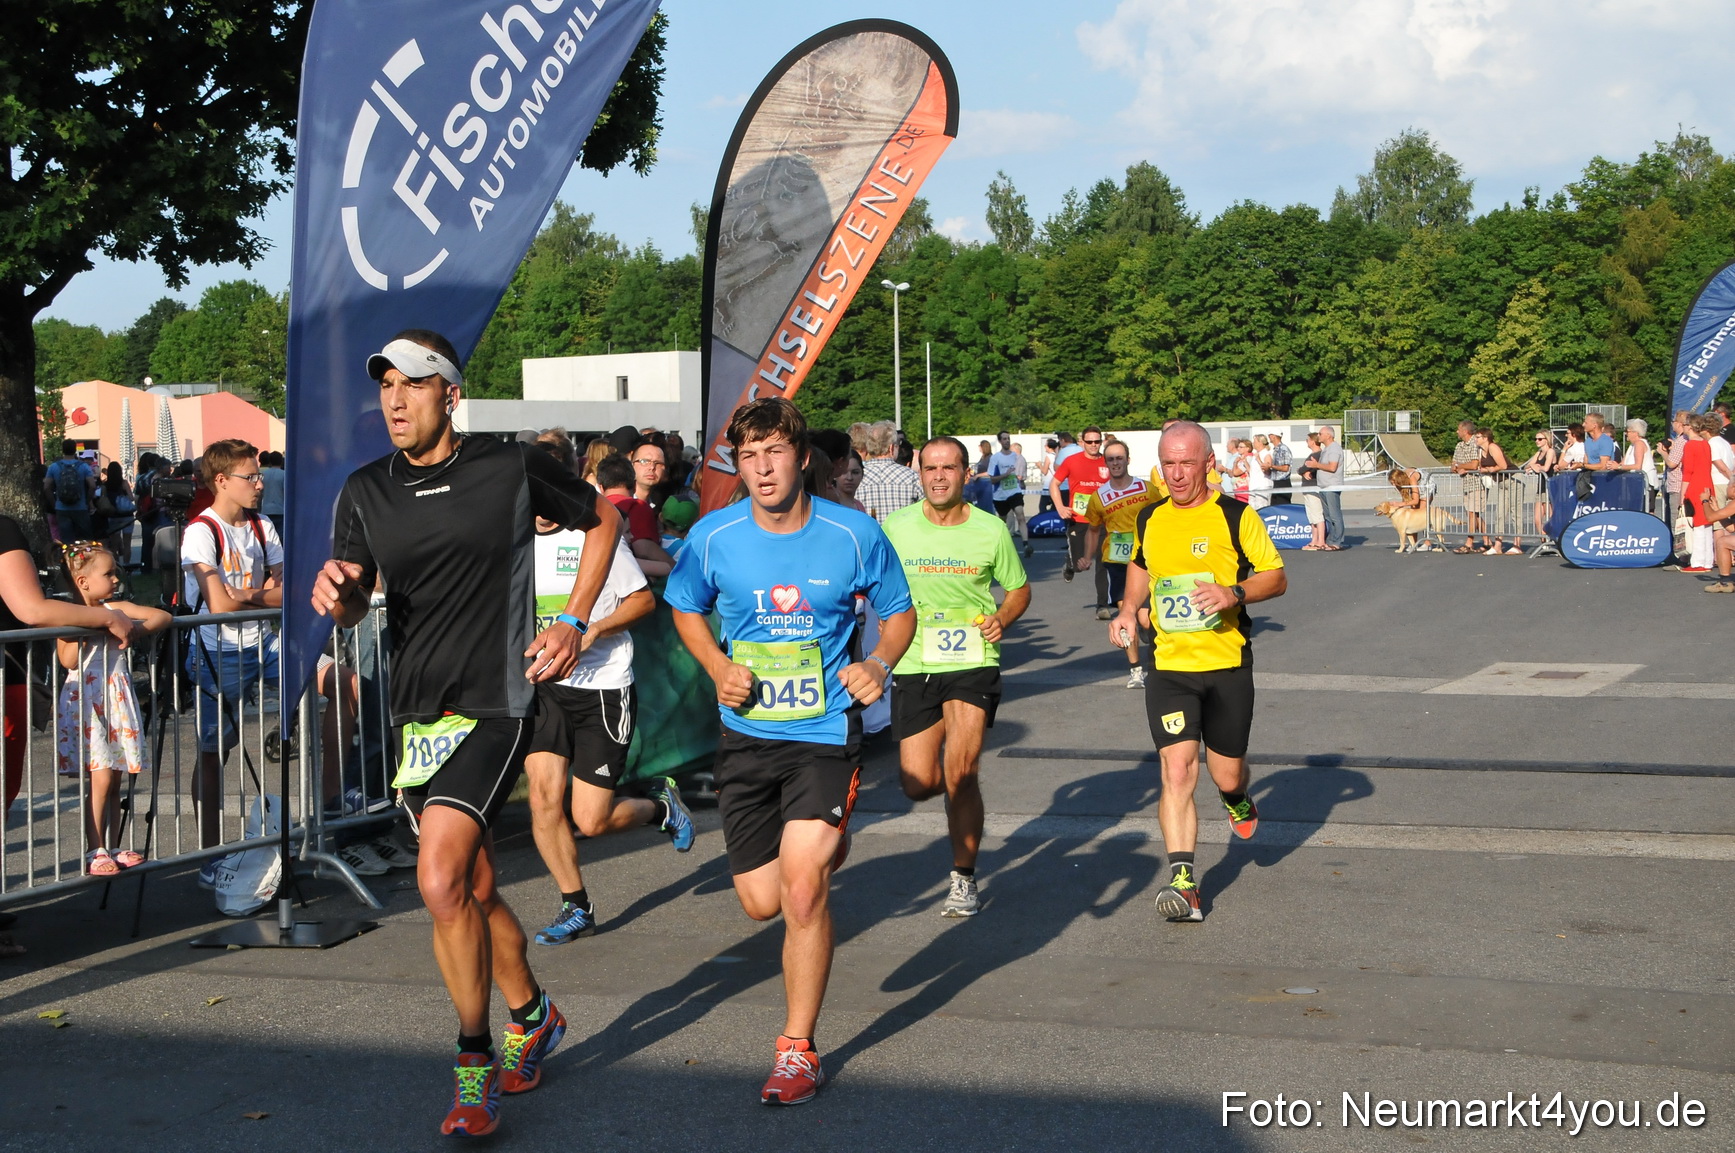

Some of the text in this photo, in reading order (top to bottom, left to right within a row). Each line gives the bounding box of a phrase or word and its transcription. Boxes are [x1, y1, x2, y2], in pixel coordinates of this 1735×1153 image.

[707, 124, 925, 476] WHSELSZENE.DE
[1679, 311, 1735, 389] Frischma
[1105, 496, 1149, 515] MAX BÖGL
[1267, 523, 1312, 535] Fische
[1193, 543, 1206, 553] FC
[1589, 535, 1659, 550] Fischer
[1596, 548, 1654, 557] AUTOMOBILE
[904, 556, 966, 567] autoladen
[918, 565, 979, 575] neumarkt
[752, 589, 767, 613] I
[1162, 595, 1205, 619] 23
[756, 612, 814, 629] camping
[792, 628, 813, 637] Berger
[937, 629, 967, 652] 32
[1166, 717, 1183, 730] FC
